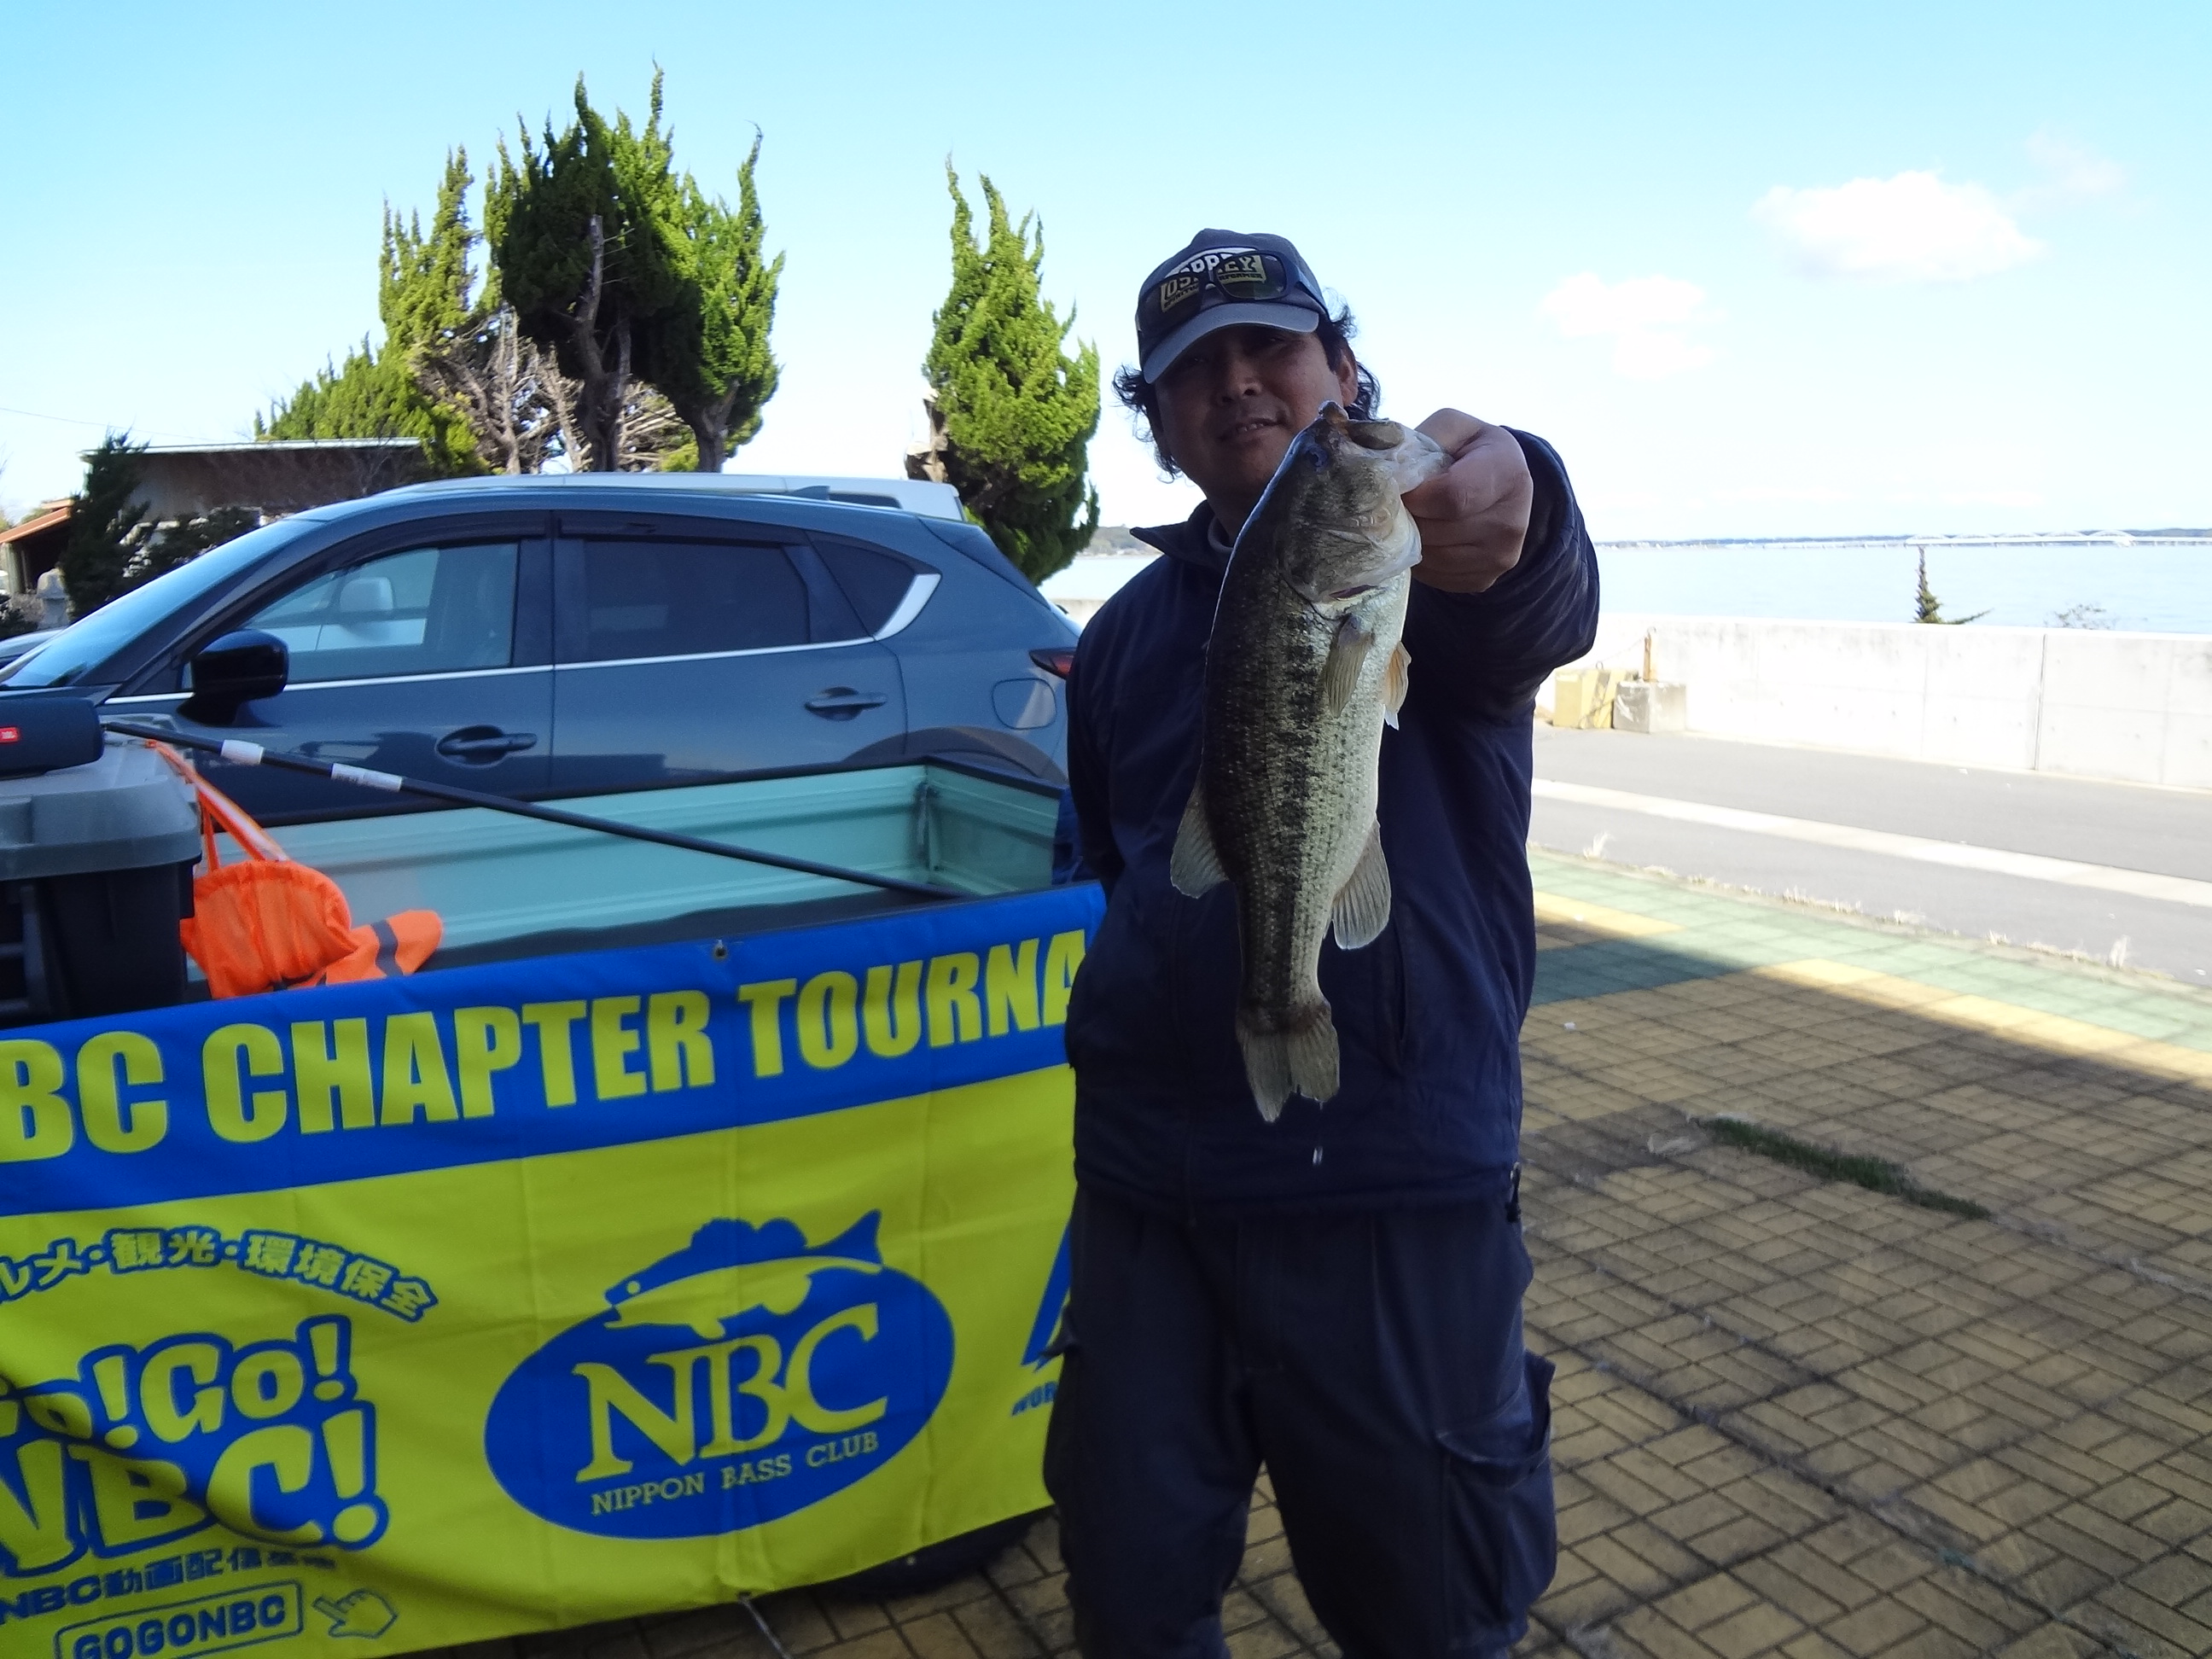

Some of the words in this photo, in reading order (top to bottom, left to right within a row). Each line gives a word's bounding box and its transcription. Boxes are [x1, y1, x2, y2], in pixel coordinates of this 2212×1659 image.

[202, 988, 715, 1144] CHAPTER
[738, 928, 1086, 1079] TOURNA
[572, 1302, 887, 1483] NBC
[591, 1471, 705, 1516] NIPPON
[720, 1453, 793, 1490] BASS
[805, 1431, 878, 1468] CLUB
[73, 1594, 286, 1659] GOGONBC
